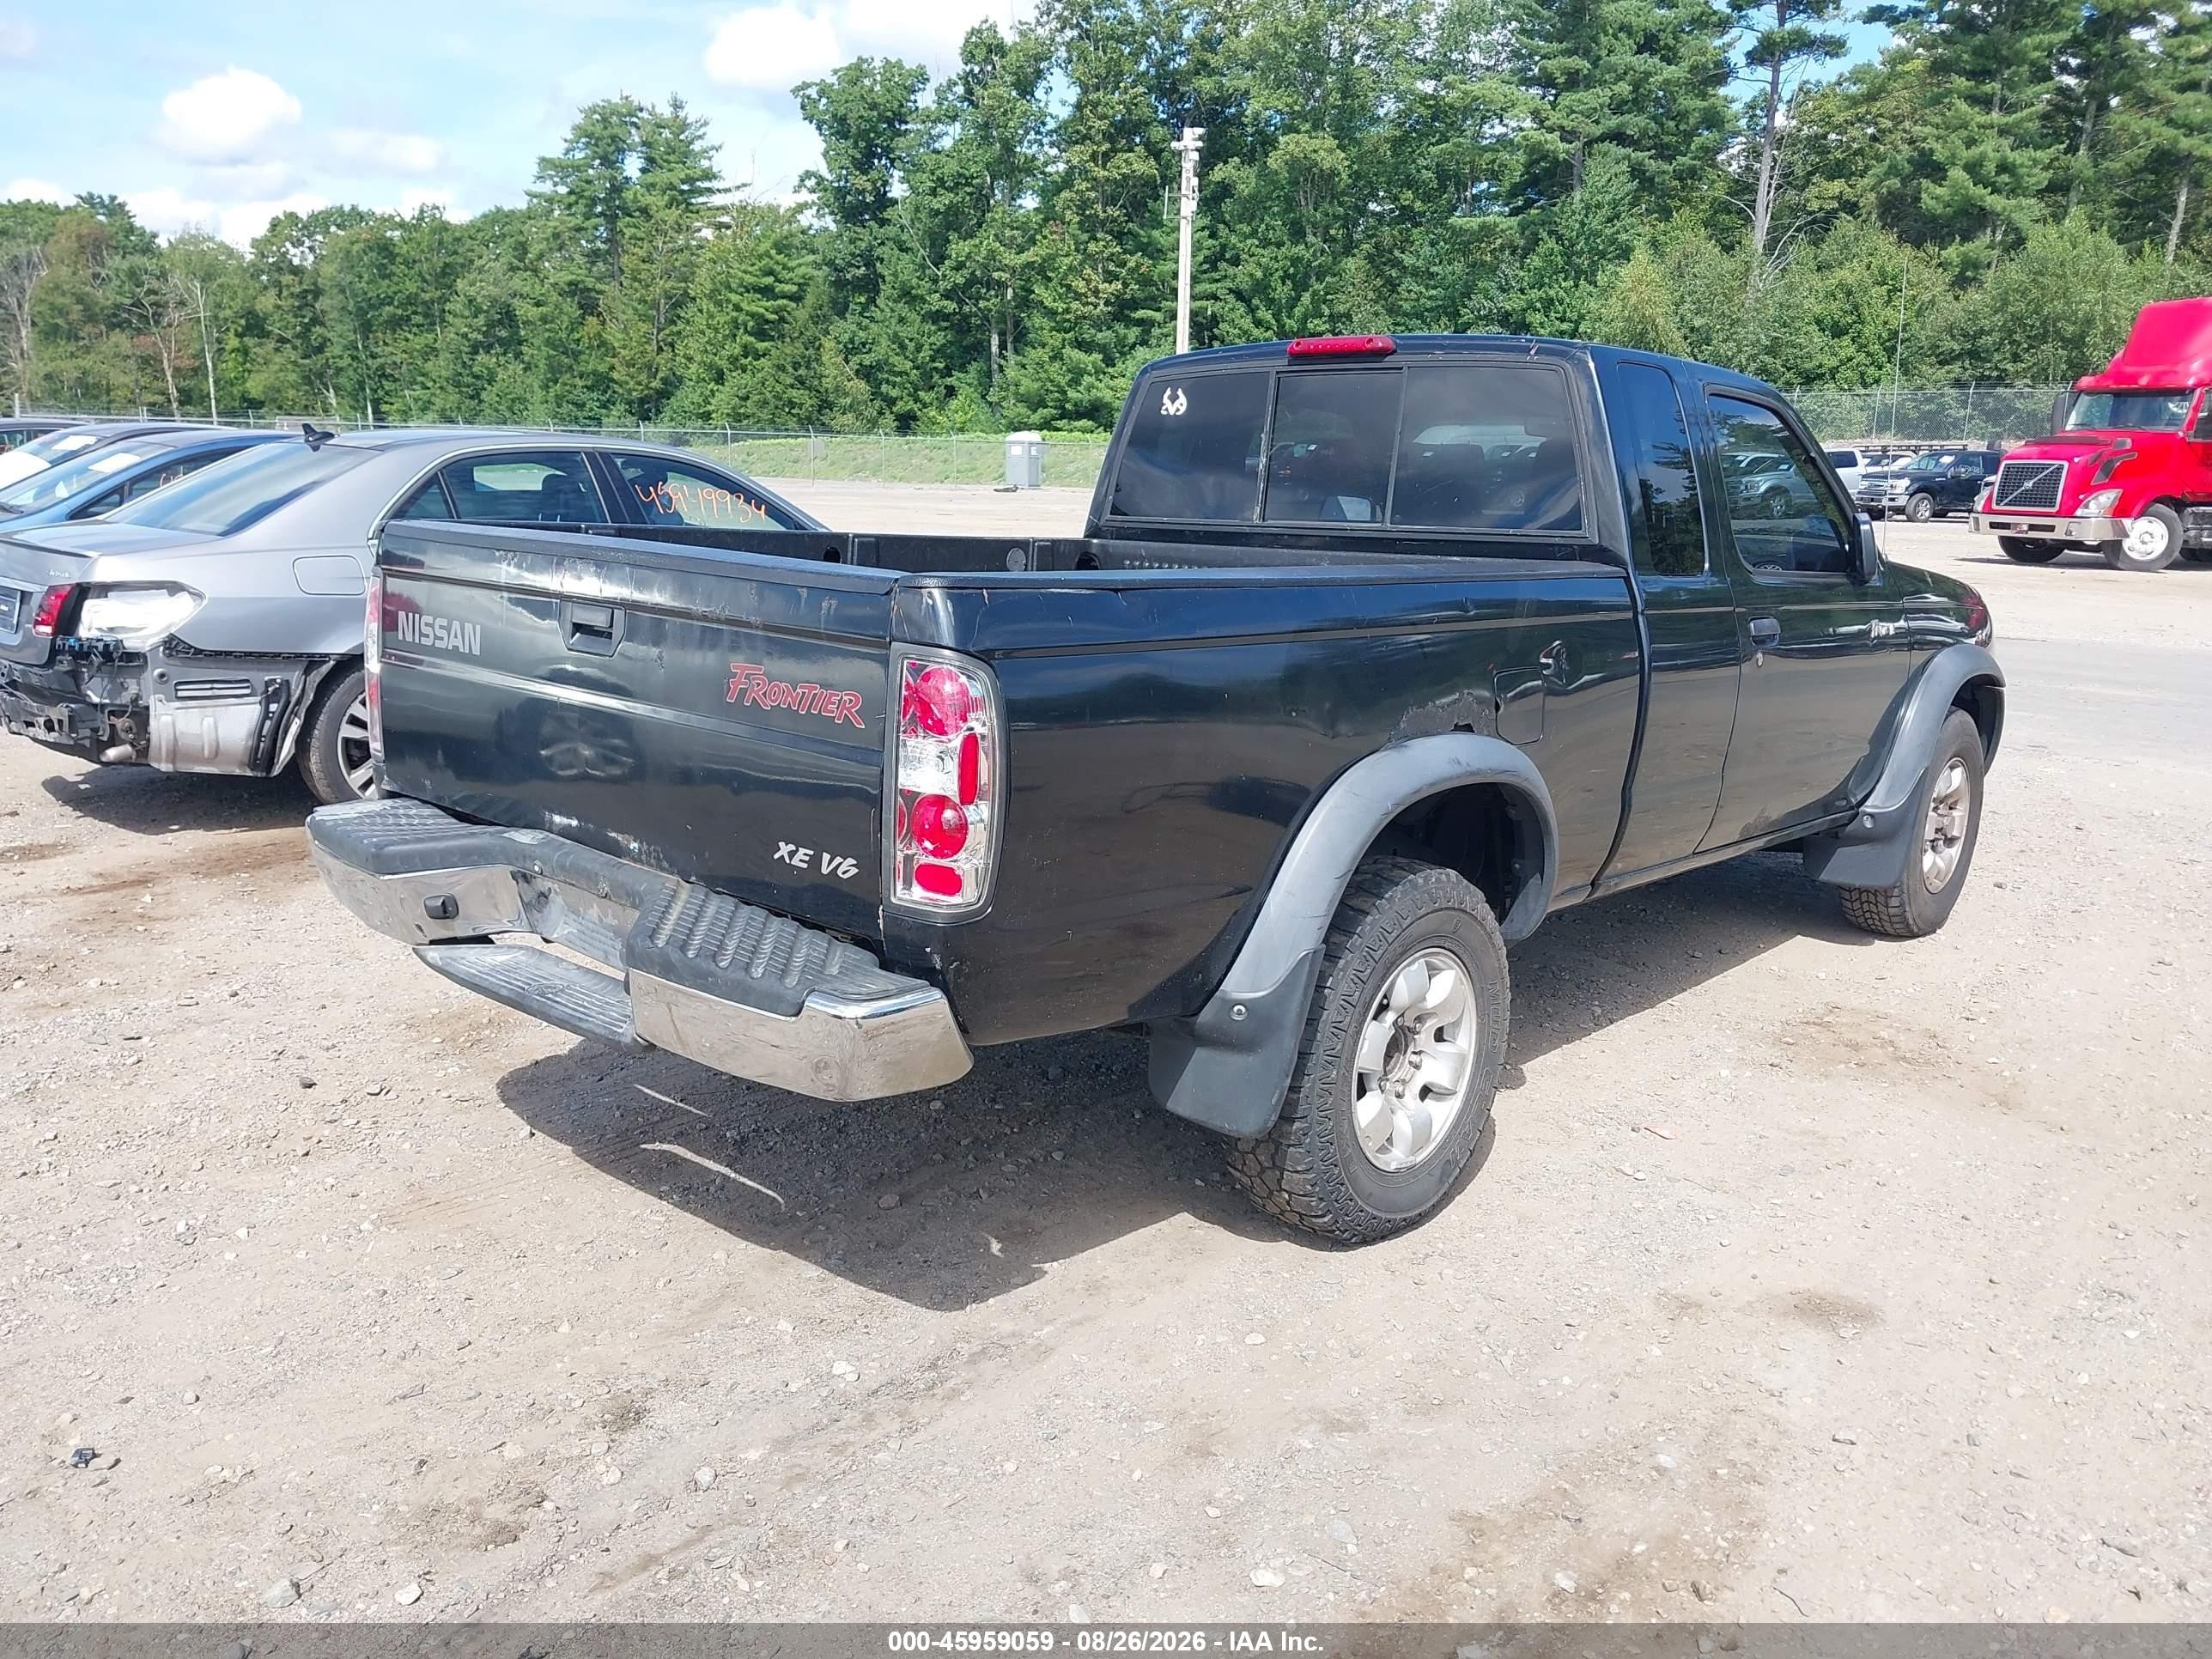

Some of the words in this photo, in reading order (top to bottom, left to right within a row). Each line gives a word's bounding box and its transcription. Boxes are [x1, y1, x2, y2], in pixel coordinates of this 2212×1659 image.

[398, 610, 482, 656] NISSAN
[726, 662, 866, 729] FRONTIER
[773, 841, 814, 869] XE
[820, 851, 860, 880] V6
